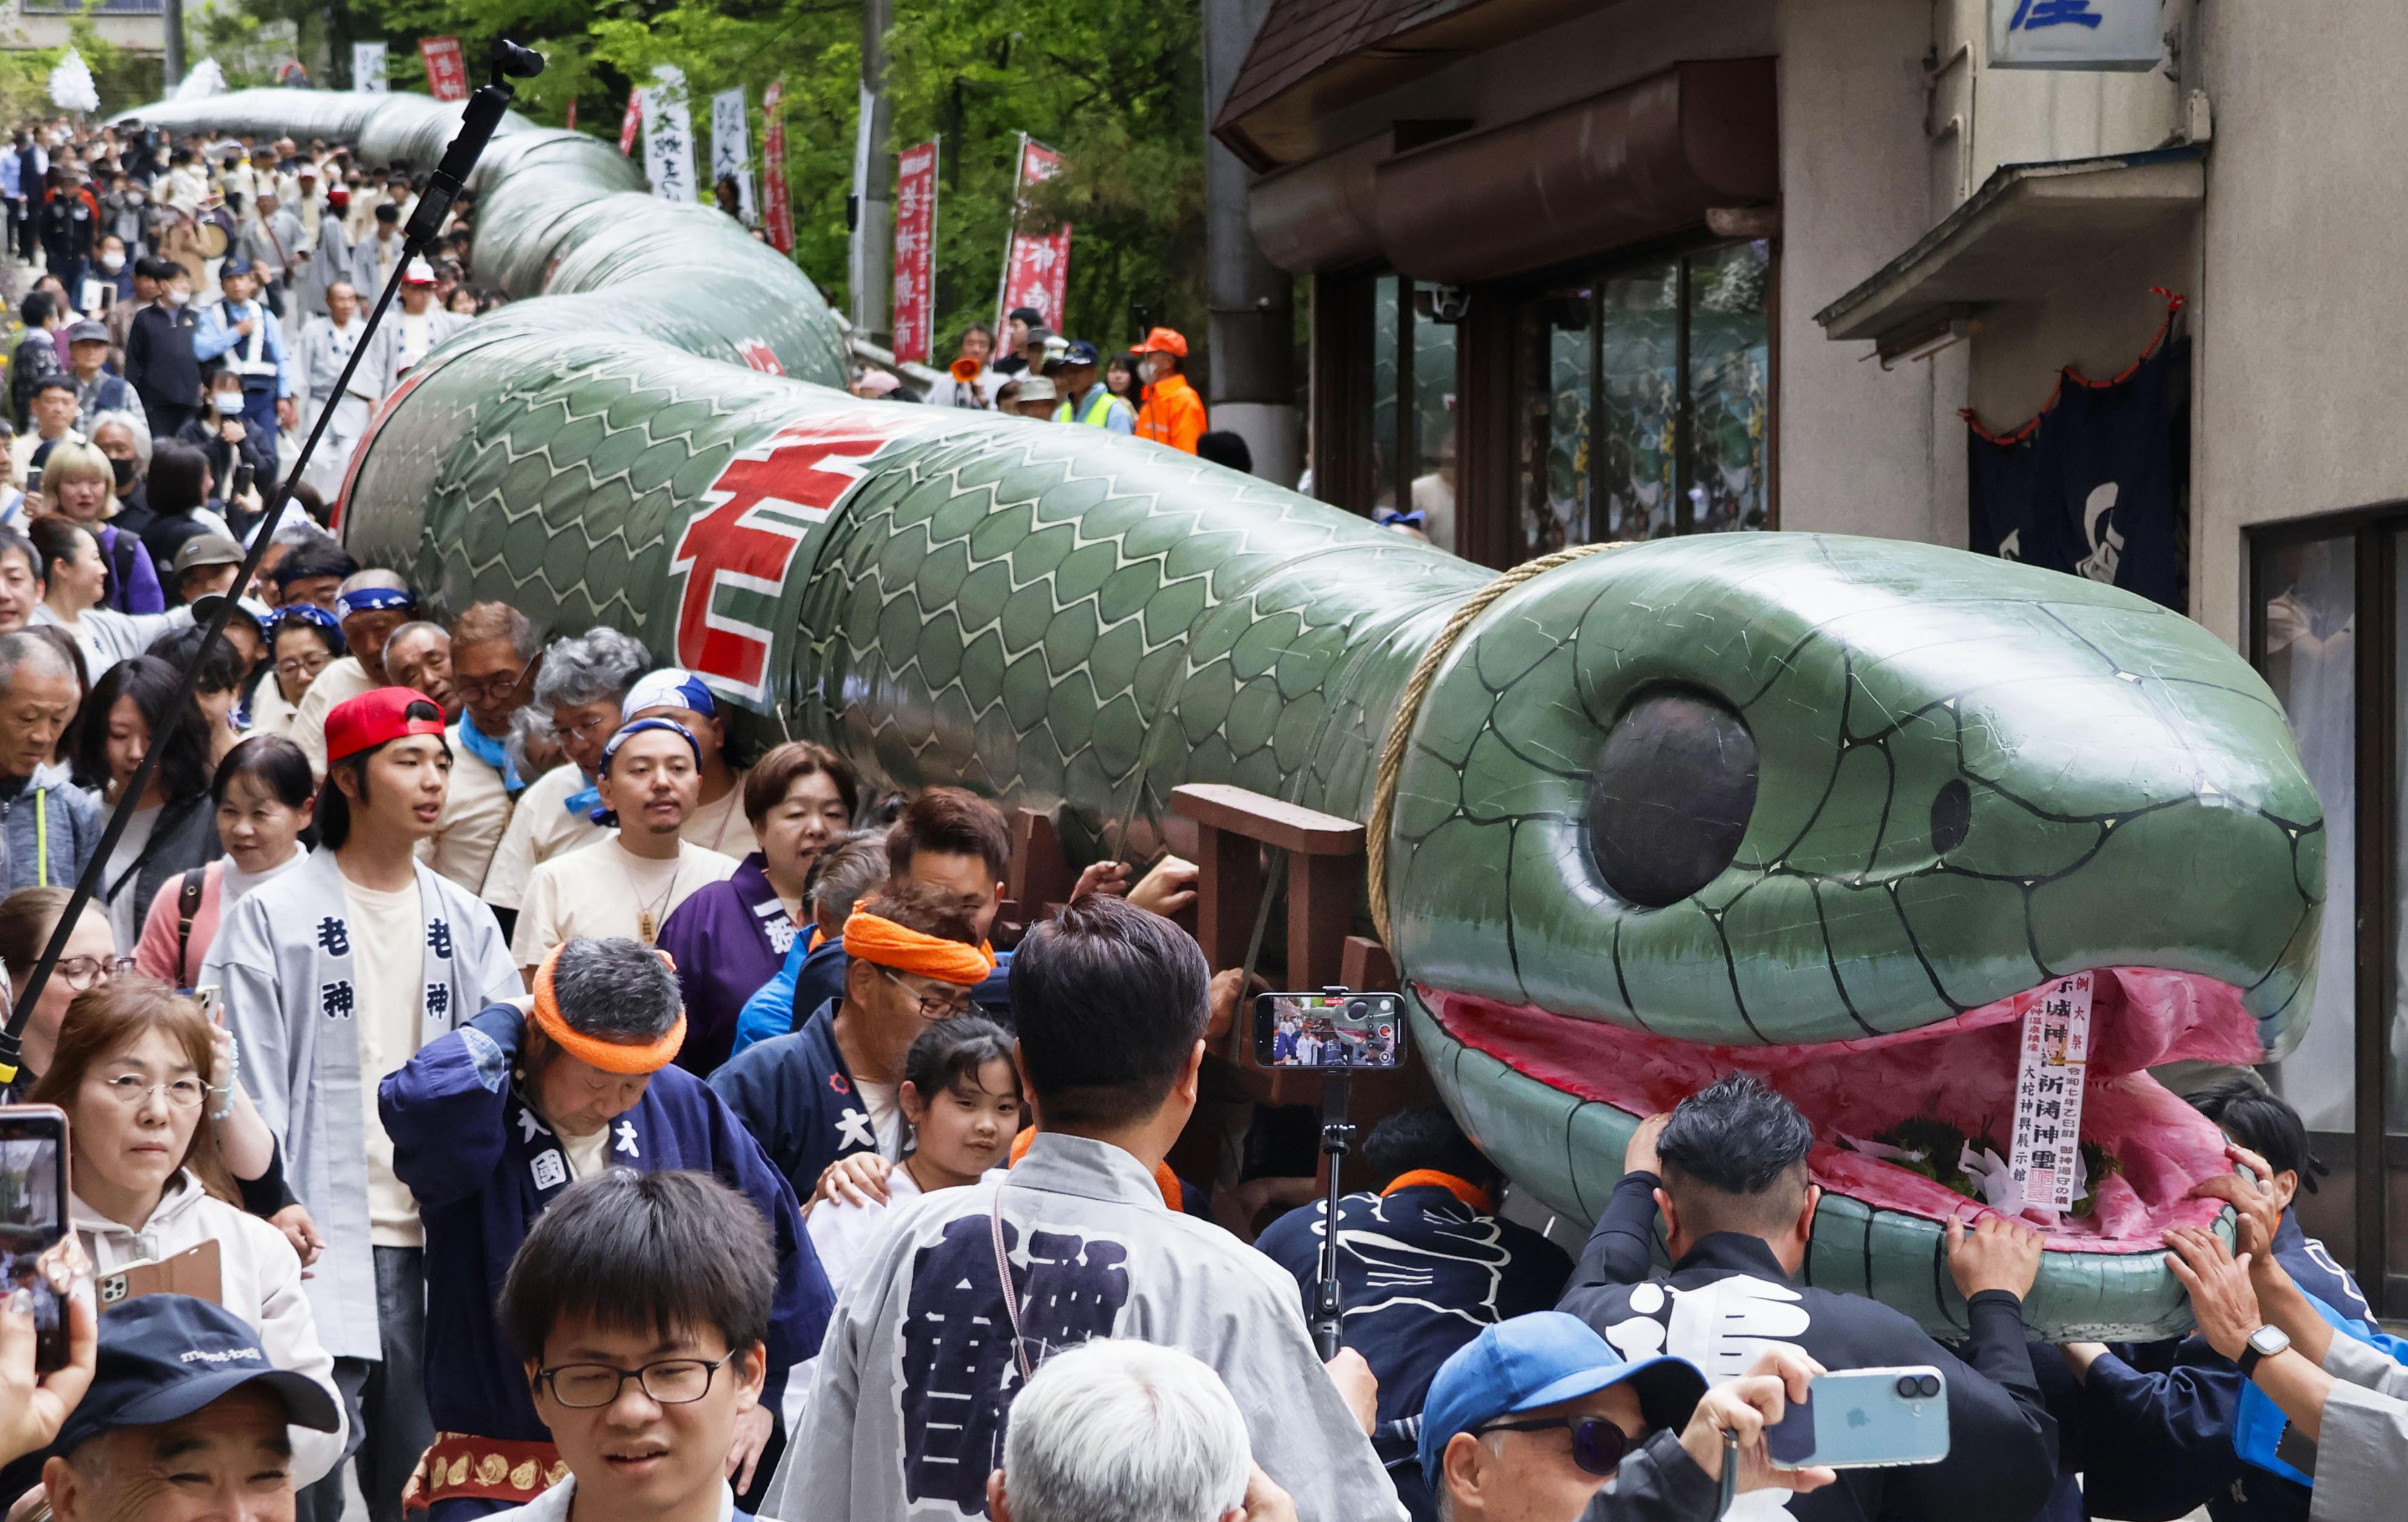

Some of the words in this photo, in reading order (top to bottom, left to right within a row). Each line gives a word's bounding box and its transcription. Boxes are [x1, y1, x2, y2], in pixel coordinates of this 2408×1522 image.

[316, 916, 354, 1018] 老神
[427, 918, 453, 1020] 老神
[2071, 976, 2089, 1050] 例大祭
[615, 1120, 640, 1158] 大
[834, 1108, 875, 1151] 大
[2014, 1065, 2035, 1199] 大蛇神輿展示館
